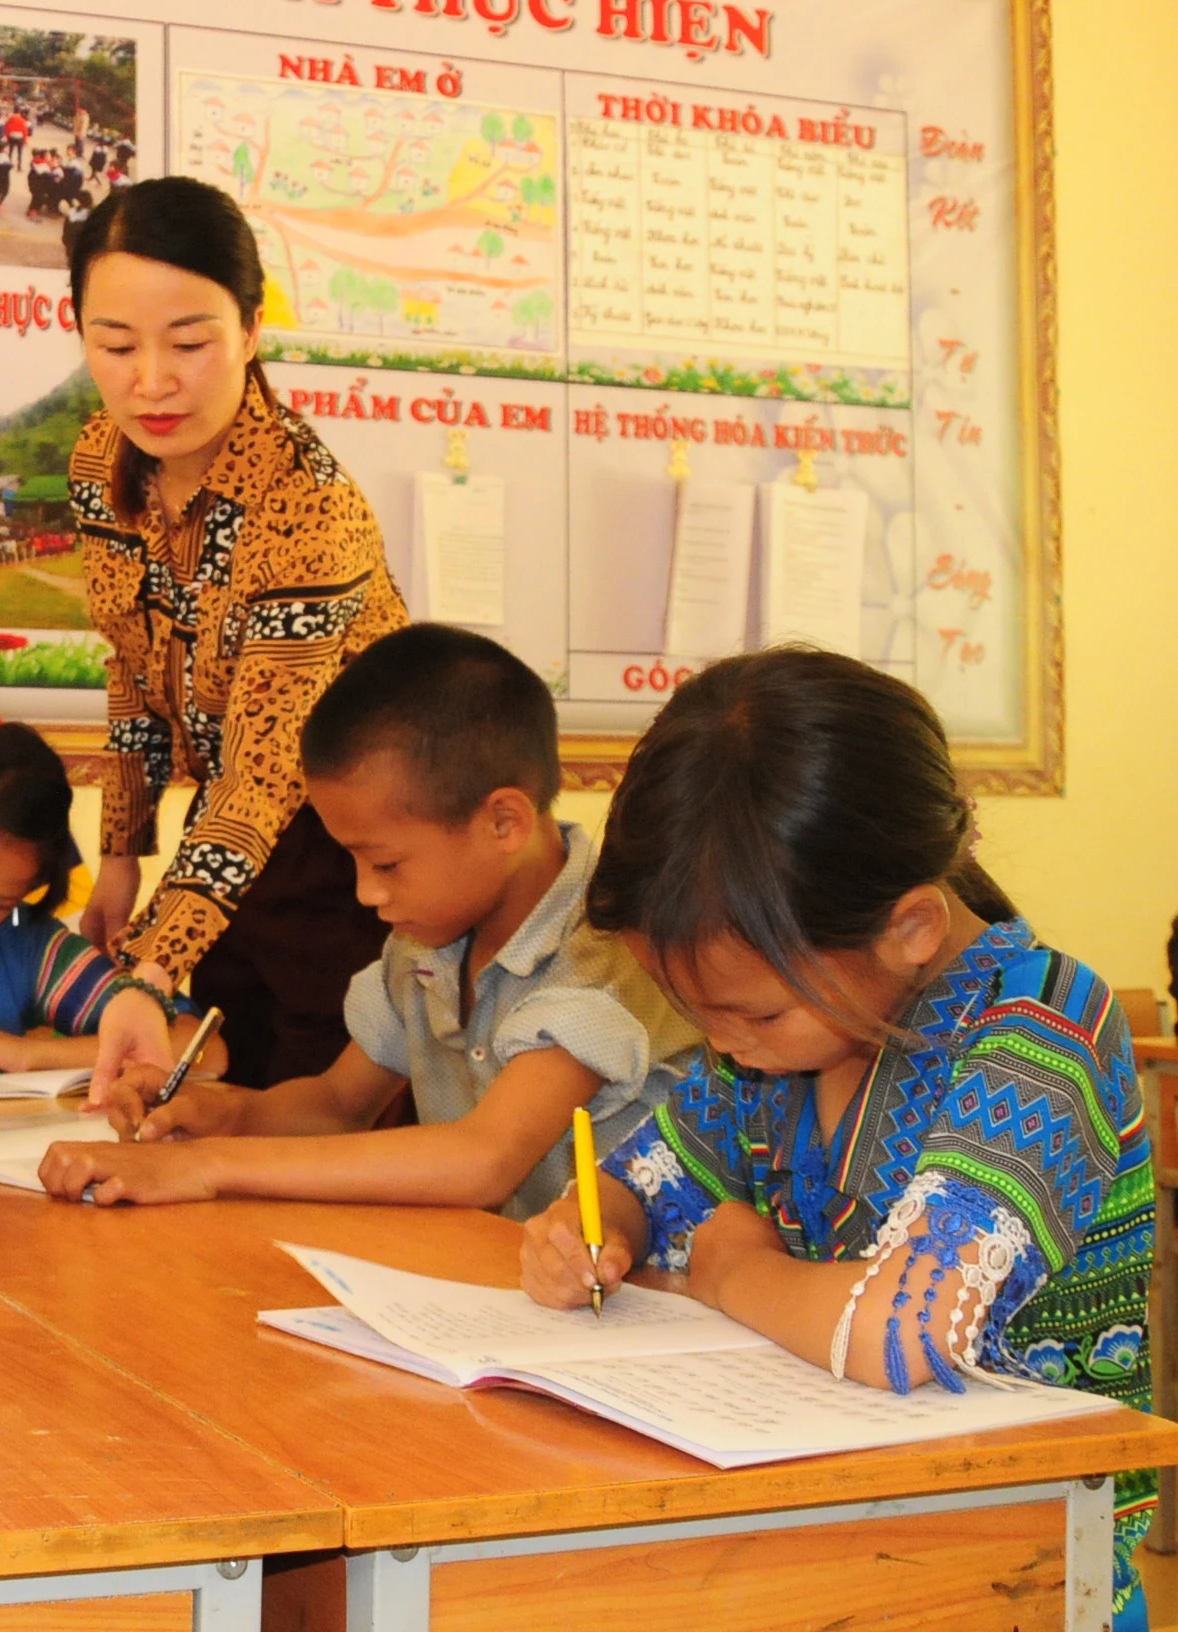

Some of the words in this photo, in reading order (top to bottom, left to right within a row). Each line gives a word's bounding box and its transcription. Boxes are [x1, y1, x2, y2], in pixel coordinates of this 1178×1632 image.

[372, 0, 572, 36] ỰC
[279, 53, 363, 88] NHÀ
[375, 65, 427, 95] EM
[435, 61, 464, 98] Ở
[598, 93, 681, 127] THỜI
[691, 104, 788, 139] KHÓA
[797, 106, 875, 150] BIỂU
[289, 377, 401, 423] PHẨM
[410, 387, 491, 428] CỦA
[501, 403, 552, 432] EM
[574, 403, 609, 443] HỆ
[616, 403, 708, 444] THỐNG
[714, 415, 767, 448] HÓA
[774, 415, 835, 451] KIẾN
